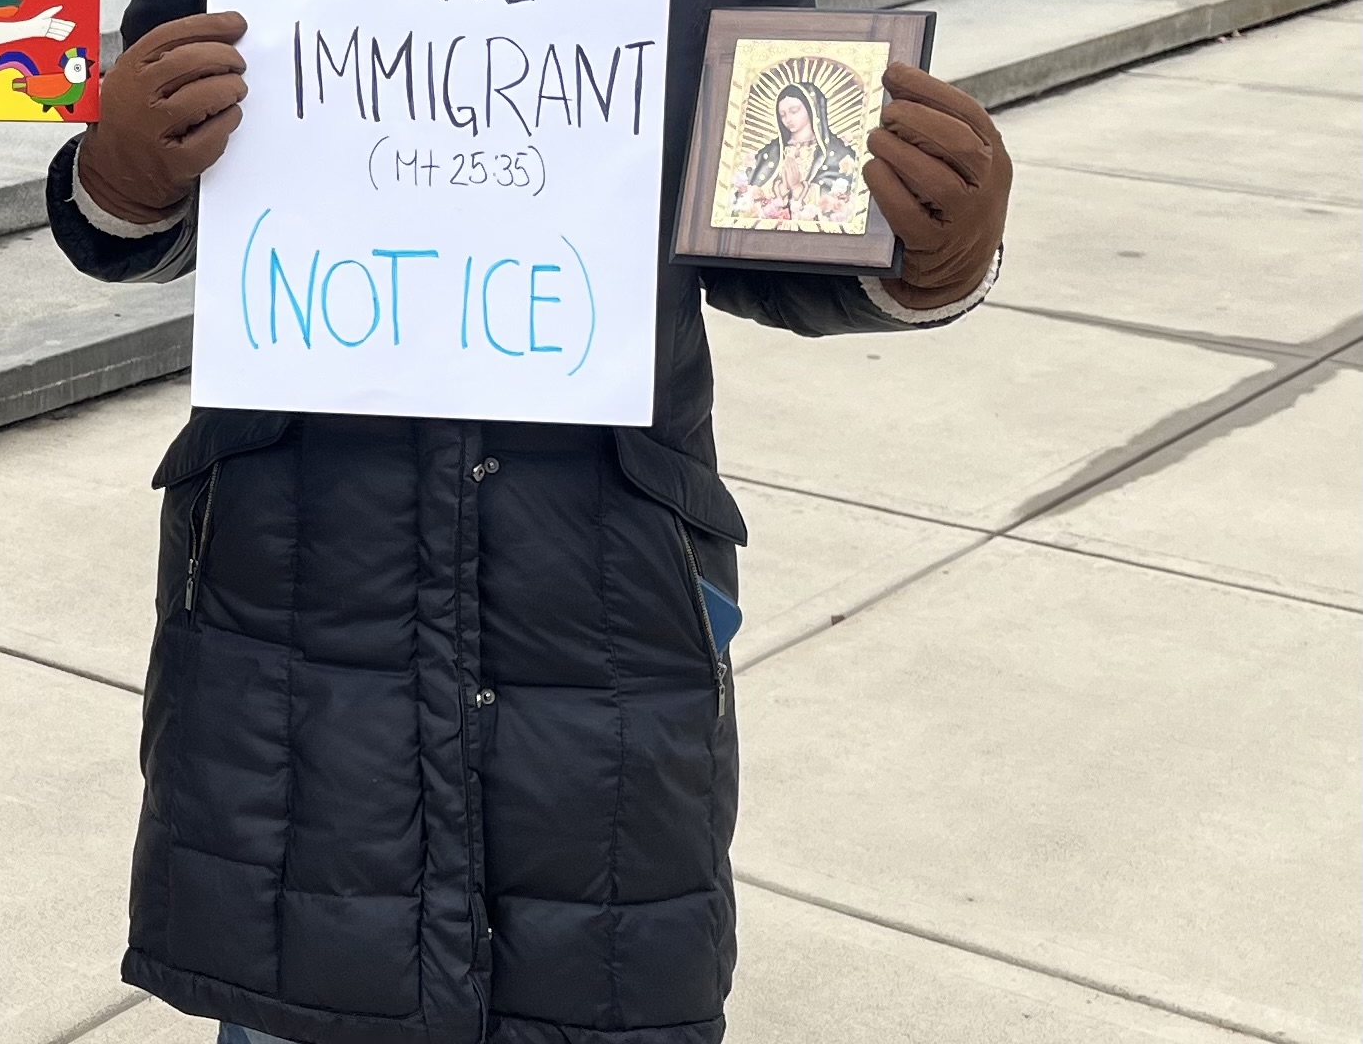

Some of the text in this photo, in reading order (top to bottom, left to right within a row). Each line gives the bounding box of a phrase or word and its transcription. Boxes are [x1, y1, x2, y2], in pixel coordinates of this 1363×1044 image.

[294, 21, 655, 137] IMMIGRANT
[450, 146, 545, 196] 25:35)
[242, 209, 595, 375] (NOT ICE)
